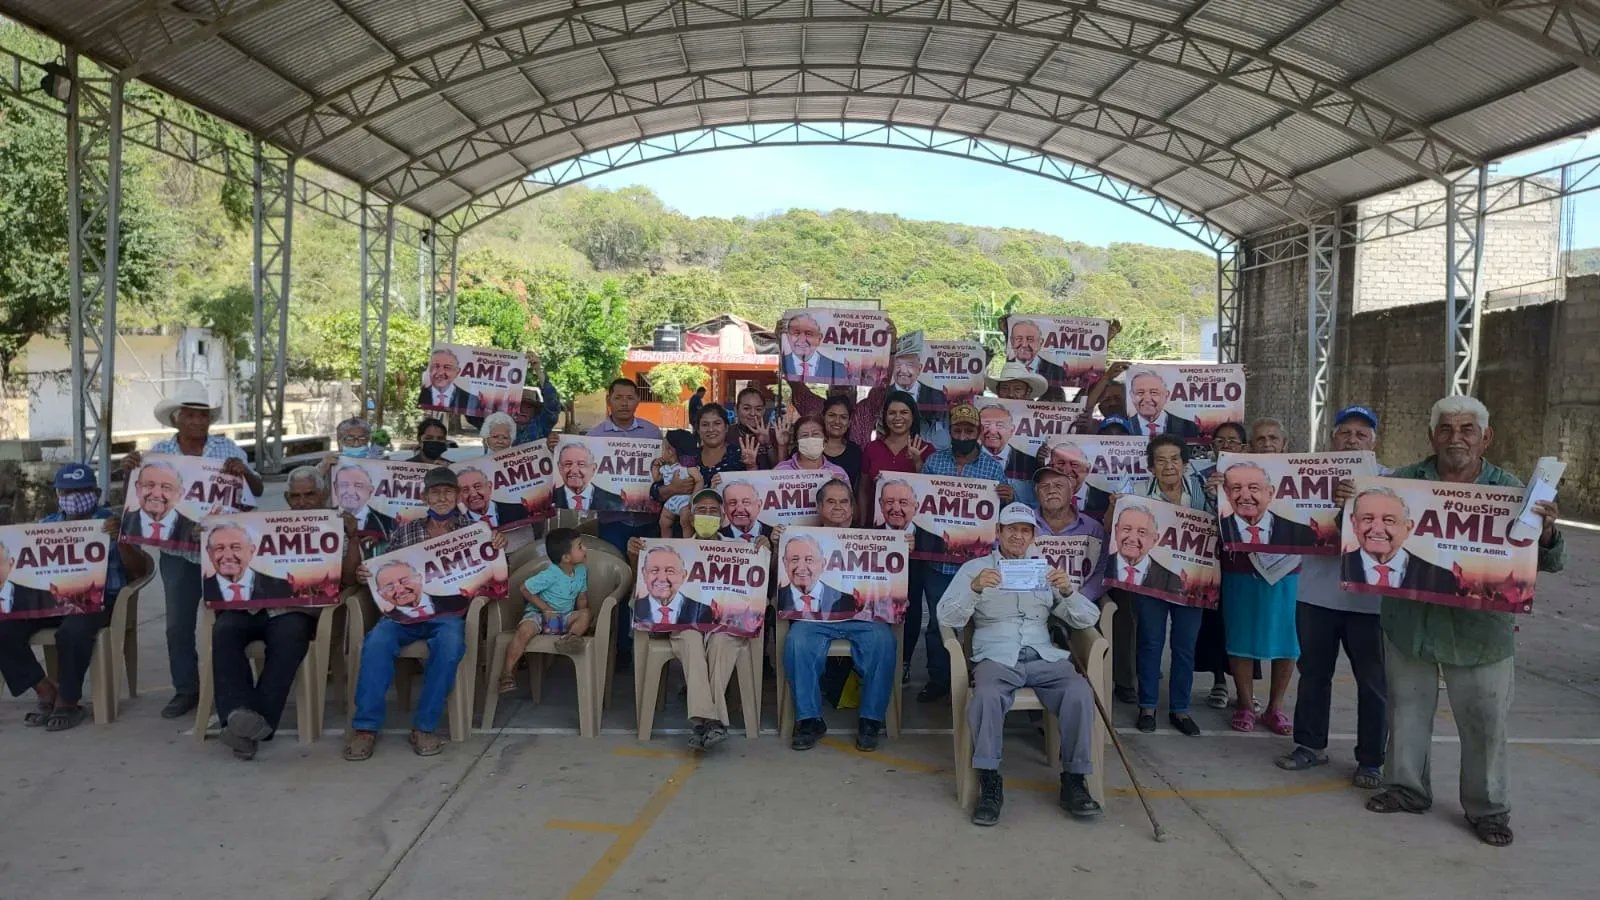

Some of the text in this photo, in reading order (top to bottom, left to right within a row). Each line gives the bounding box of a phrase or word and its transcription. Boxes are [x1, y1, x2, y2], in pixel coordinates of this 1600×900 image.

[839, 321, 874, 329] #QueSiga
[823, 327, 888, 347] AMLO
[1044, 332, 1105, 351] AMLO
[460, 362, 522, 384] AMLO
[923, 357, 982, 374] AMLO
[1186, 375, 1226, 383] #QueSiga
[1170, 383, 1241, 401] AMLO
[1033, 411, 1071, 422] #QueSiga
[494, 453, 515, 461] VAMOS
[522, 445, 542, 454] VOTAR
[503, 455, 538, 468] #QueSiga
[615, 450, 652, 458] #QueSiga
[597, 456, 651, 475] AML
[1091, 455, 1148, 474] AML
[1298, 467, 1352, 476] #QueSiga
[494, 457, 553, 490] AMLO
[375, 479, 425, 499] AML
[938, 488, 979, 499] #QueSiga
[1275, 476, 1341, 502] AML
[1432, 489, 1471, 498] VAMOS
[1485, 494, 1524, 503] VOTAR
[763, 489, 816, 510] AML
[919, 495, 994, 520] AMLO
[1444, 500, 1510, 516] #QueSiga
[1176, 511, 1202, 522] VAMOS
[25, 528, 56, 536] VAMOS
[276, 525, 320, 534] #QueSiga
[35, 536, 85, 546] #QueSiga
[257, 532, 339, 556] AMLO
[424, 539, 451, 551] VAMOS
[459, 528, 484, 540] VOTAR
[845, 542, 887, 552] #QueSiga
[16, 542, 106, 569] AMLO
[436, 540, 478, 557] #QueSiga
[1042, 547, 1084, 555] #QueSiga
[1483, 548, 1508, 556] ABRIL
[424, 541, 499, 584] AMLO
[707, 554, 749, 565] #QueSiga
[826, 550, 904, 574] AMLO
[1031, 555, 1091, 577] MLO
[687, 562, 766, 588] AMLO
